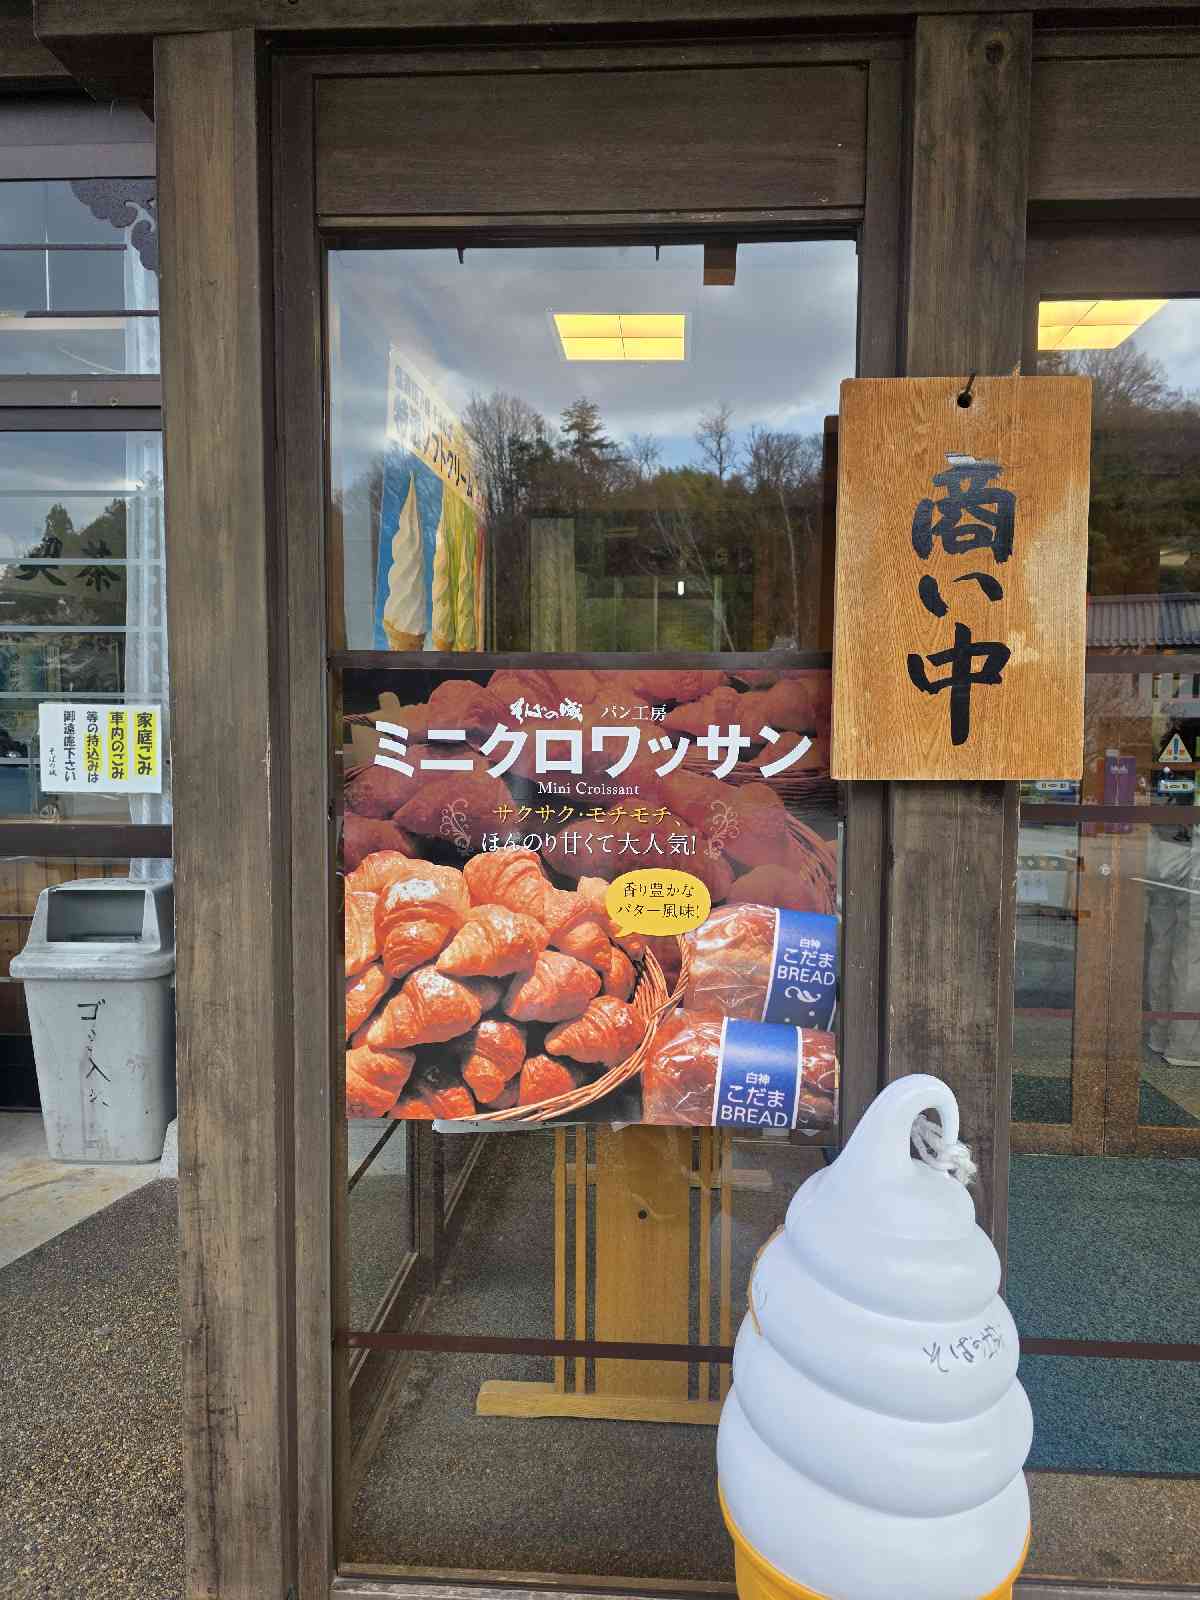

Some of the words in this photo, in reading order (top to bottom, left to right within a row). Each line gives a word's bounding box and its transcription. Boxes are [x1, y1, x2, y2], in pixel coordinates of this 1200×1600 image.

[907, 451, 1018, 746] 商い中
[600, 702, 668, 722] パン工房
[63, 710, 77, 783] 御遠慮下さい
[86, 710, 100, 784] 等の持込みは
[109, 711, 125, 780] 車内のごみ
[136, 711, 153, 776] 家庭ごみ
[373, 720, 814, 780] ミニクロワッサン
[537, 781, 570, 795] Mini
[575, 781, 640, 796] Croissant
[481, 831, 697, 856] ほんのり甘くて大人気!
[623, 882, 695, 898] 香り豊かな
[617, 903, 700, 919] バター風味!
[799, 938, 821, 949] 白神
[783, 948, 835, 968] こだま
[776, 965, 836, 986] BREAD
[745, 1072, 770, 1085] 白神
[727, 1084, 786, 1109] こだま
[720, 1104, 789, 1128] BREAD
